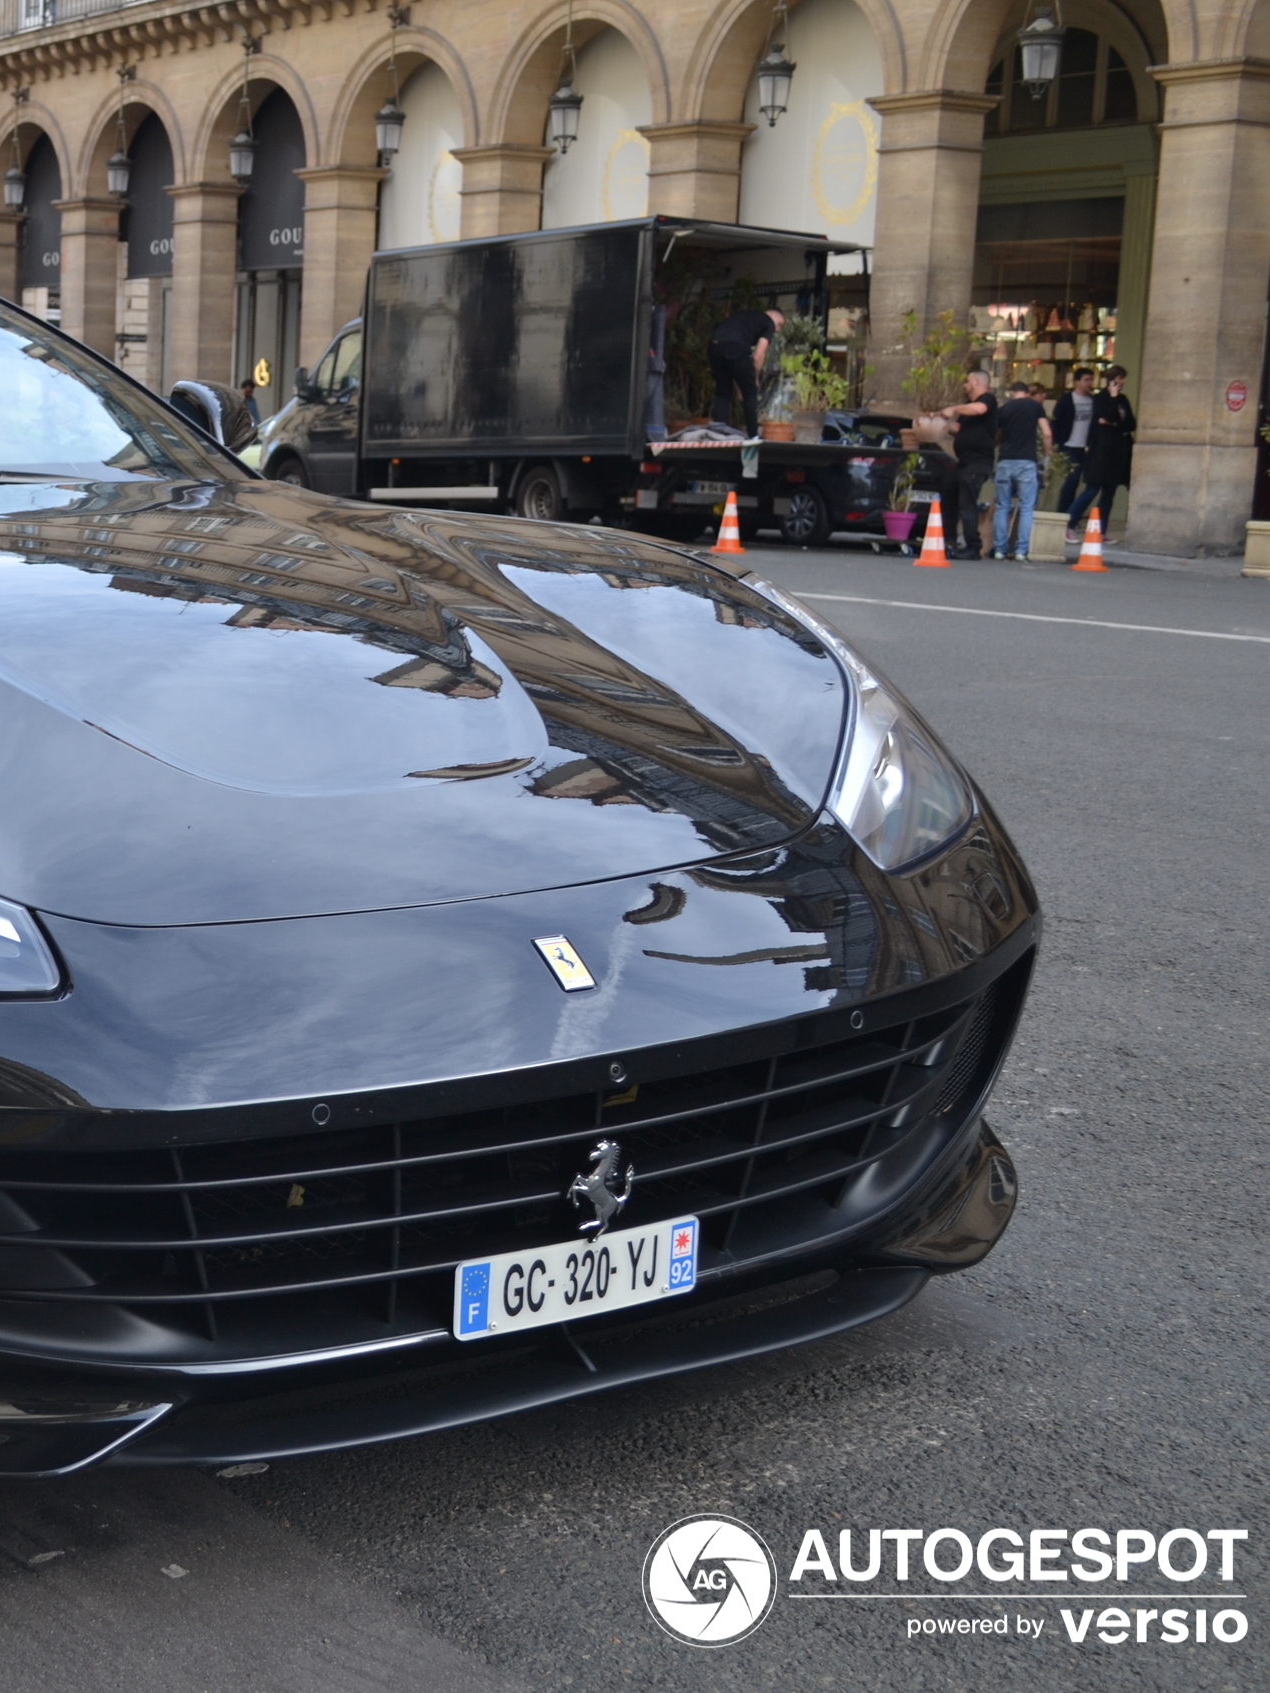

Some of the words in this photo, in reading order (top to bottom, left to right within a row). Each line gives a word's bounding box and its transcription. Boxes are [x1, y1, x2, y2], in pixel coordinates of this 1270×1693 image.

[270, 227, 302, 246] GOU
[670, 1259, 692, 1285] 92
[468, 1302, 480, 1324] F
